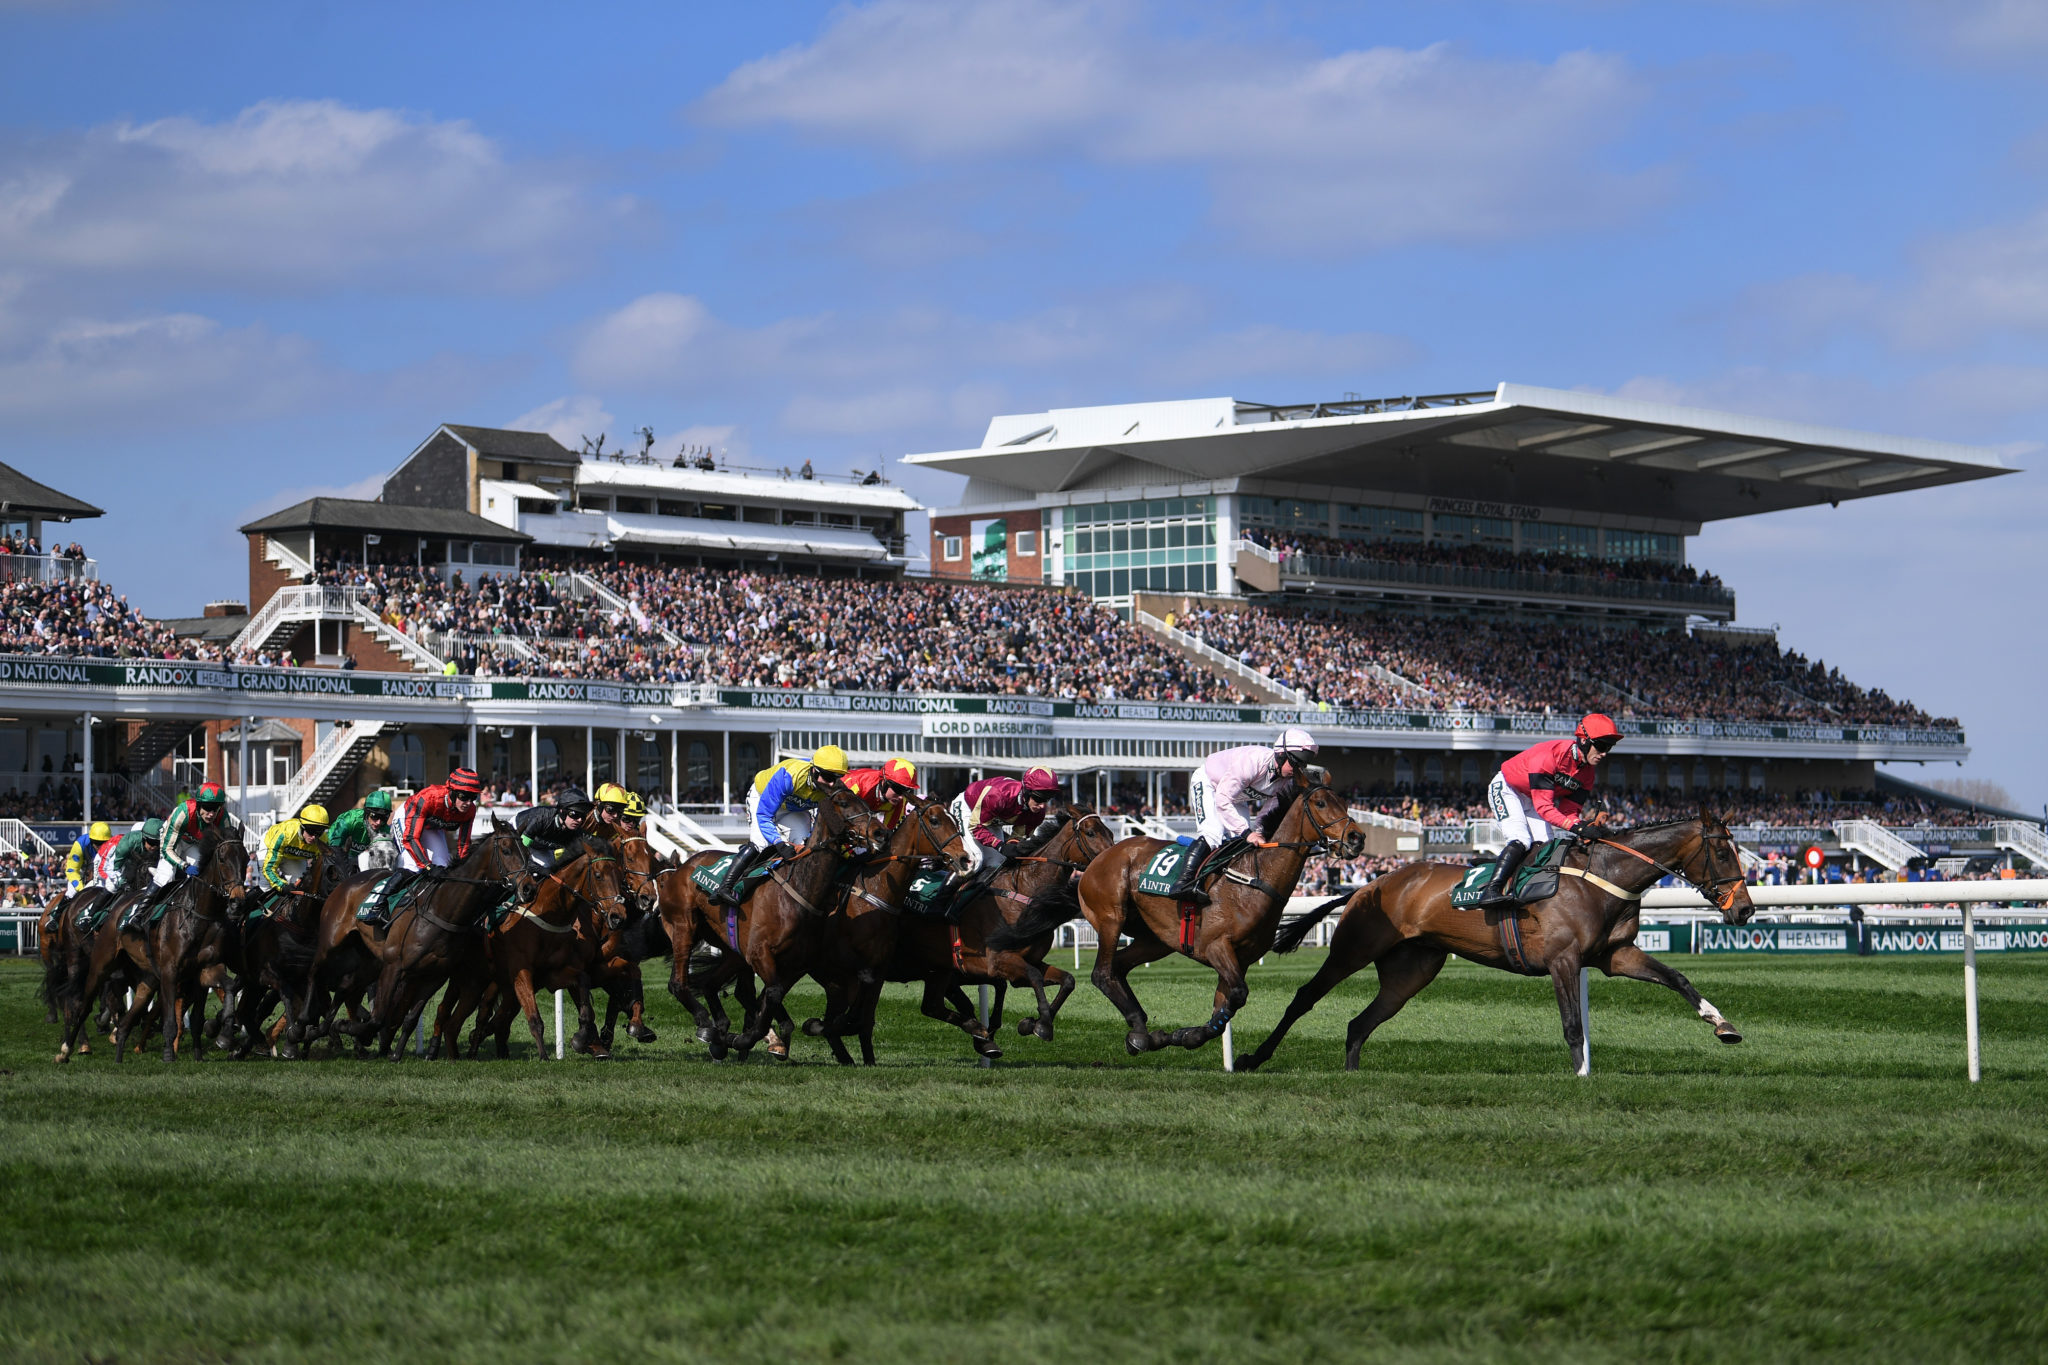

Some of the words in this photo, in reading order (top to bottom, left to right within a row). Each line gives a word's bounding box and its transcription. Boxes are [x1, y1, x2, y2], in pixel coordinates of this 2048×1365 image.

[15, 663, 90, 681] NATIONAL
[126, 667, 193, 684] RANDOX
[241, 674, 287, 690] GRAND
[289, 678, 354, 693] NATIONAL
[382, 681, 434, 696] RANDOX
[441, 684, 483, 695] HEALTH
[529, 683, 584, 699] RANDOX
[621, 689, 663, 703] GRAND
[752, 693, 799, 707] RANDOX
[807, 697, 845, 707] HEALTH
[852, 697, 891, 711] GRAND
[893, 698, 959, 712] NATIONAL
[987, 700, 1028, 713] RANDOX
[1075, 705, 1116, 718] RANDOX
[1122, 709, 1155, 717] HEALTH
[1160, 708, 1193, 721] GRAND
[1194, 709, 1241, 721] NATIONAL
[1338, 713, 1369, 725] GRAND
[1369, 714, 1411, 726] NATIONAL
[932, 722, 969, 734] LORD
[974, 723, 1033, 735] DARESBURY
[1429, 716, 1471, 729] RANDOX
[1657, 723, 1696, 734] RANDOX
[1493, 782, 1508, 820] RANDOX
[1428, 829, 1466, 843] RANDOX
[1148, 852, 1180, 876] 19
[1140, 877, 1171, 893] AINTR
[1464, 866, 1486, 888] 7
[1454, 891, 1483, 902] AINT
[1703, 928, 1774, 949] RANDOX
[1786, 932, 1838, 946] HEALTH
[1871, 932, 1938, 951] RANDOX
[1948, 933, 1997, 947] HELTH
[2005, 931, 2048, 948] RANDO
